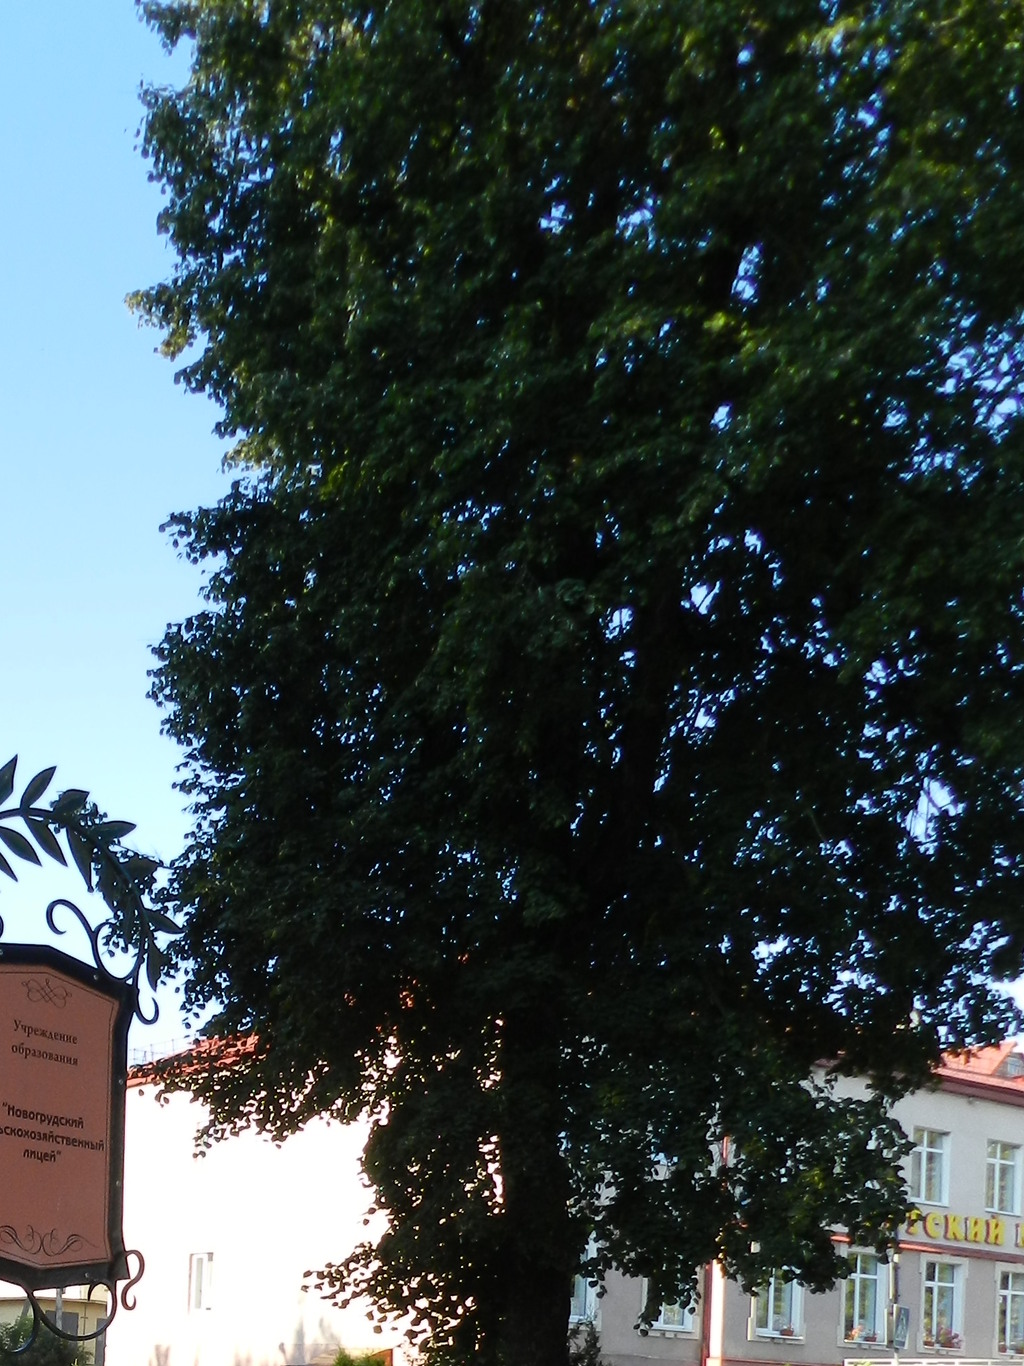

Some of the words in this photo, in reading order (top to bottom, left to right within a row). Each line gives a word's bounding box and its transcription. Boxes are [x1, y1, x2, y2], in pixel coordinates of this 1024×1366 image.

[13, 1019, 78, 1045] Учреждение
[11, 1042, 78, 1066] образования
[2, 1102, 84, 1129] "Новогрудский
[23, 1149, 61, 1163] лицей"
